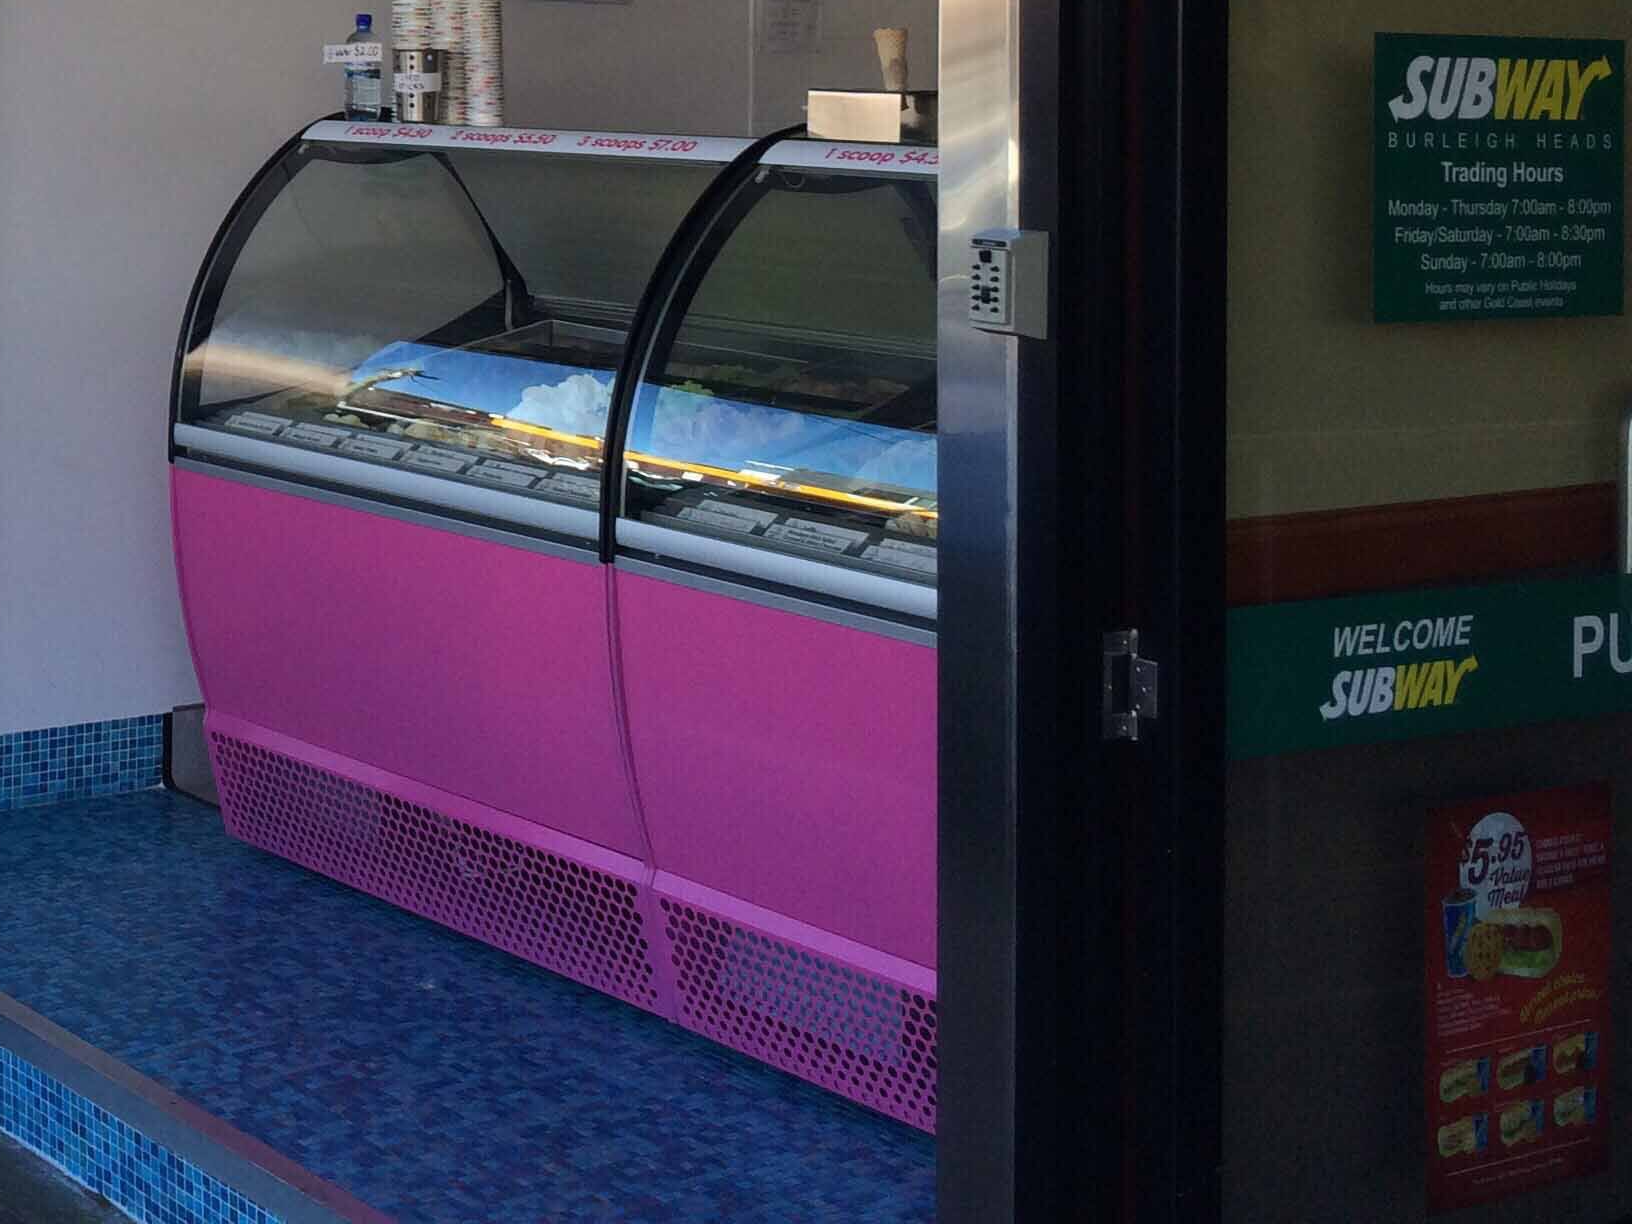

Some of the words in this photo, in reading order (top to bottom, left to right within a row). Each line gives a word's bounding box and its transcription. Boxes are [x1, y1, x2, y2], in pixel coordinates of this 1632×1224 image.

[1388, 55, 1612, 123] SUBWAY
[1388, 132, 1515, 149] BURLEIGH
[1537, 133, 1612, 149] HEADS
[837, 150, 894, 164] scoop
[1441, 162, 1507, 187] Trading
[1513, 162, 1564, 182] Hours
[1387, 200, 1438, 219] Monday
[1451, 200, 1507, 218] Thursday
[1512, 199, 1557, 216] 7:00am
[1394, 227, 1494, 247] Friday/Saturday
[1420, 253, 1468, 272] Sunday
[1334, 615, 1474, 657] WELCOME
[1319, 655, 1479, 721] SUBWAY
[1456, 833, 1528, 884] $5.95
